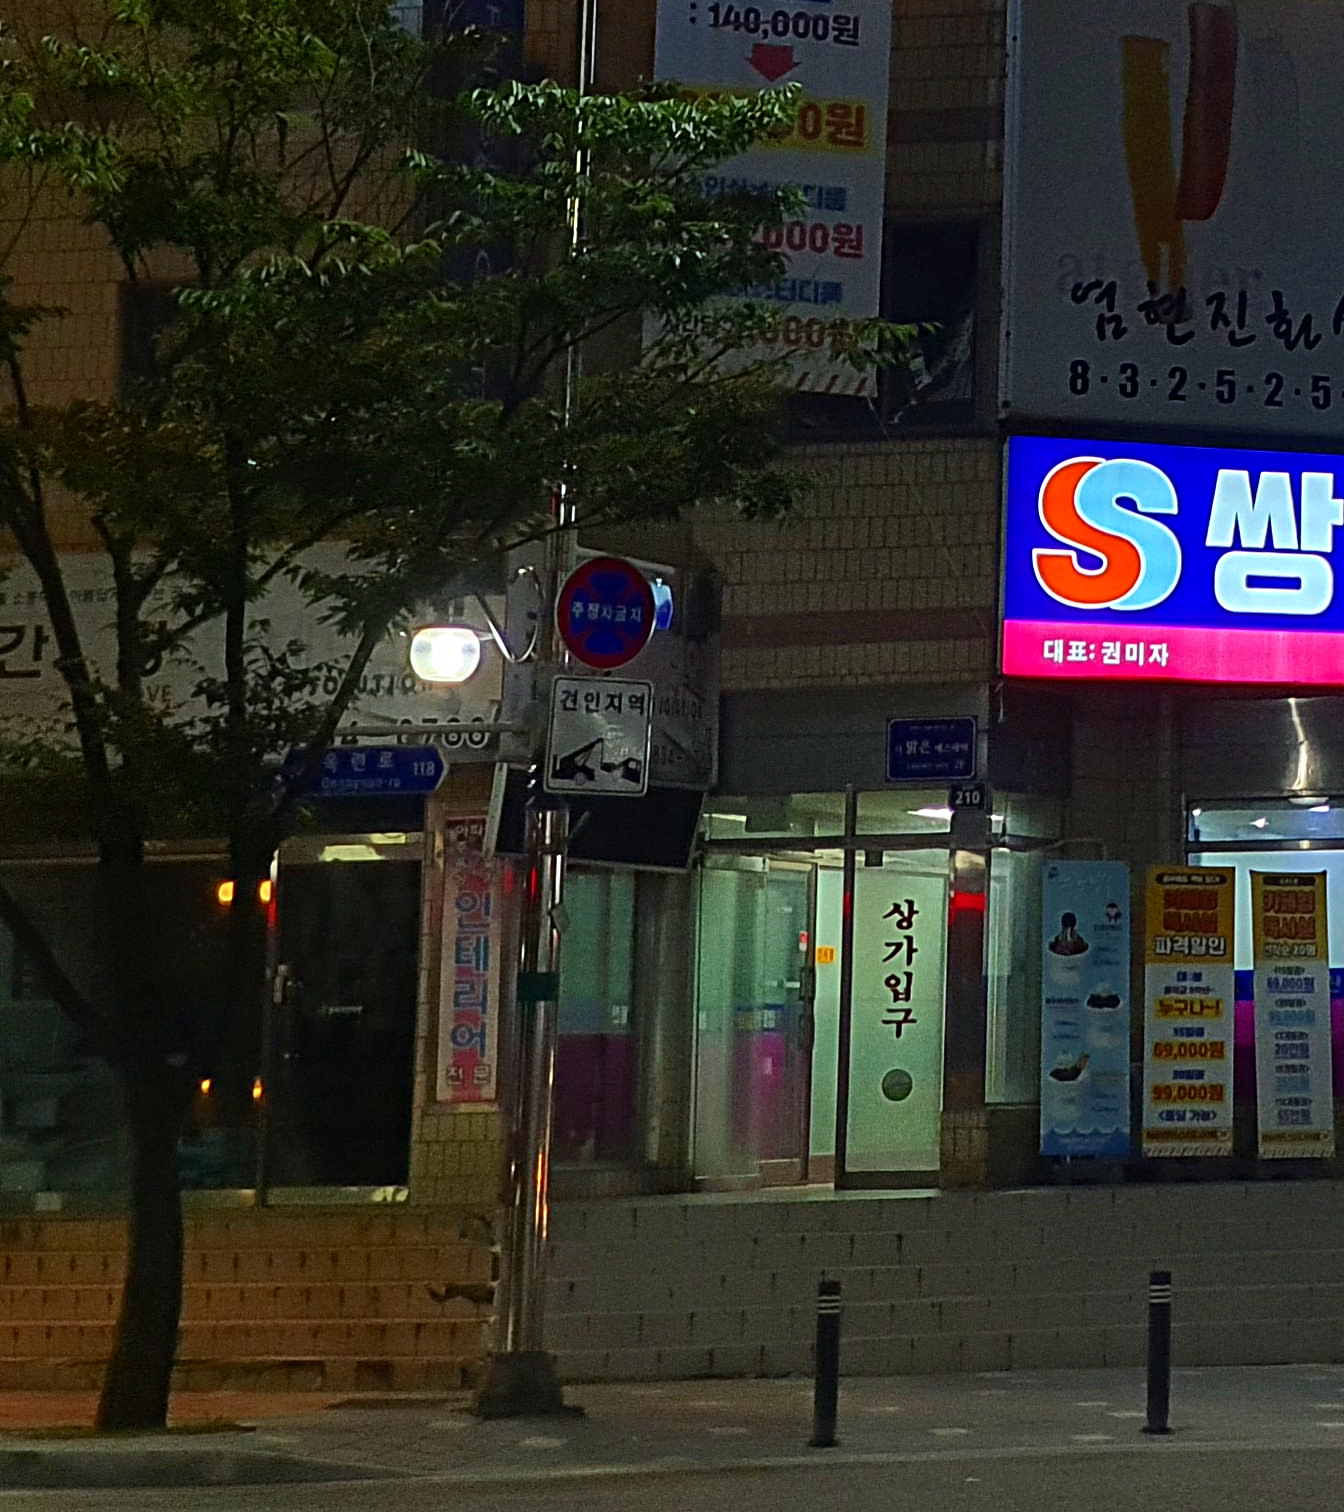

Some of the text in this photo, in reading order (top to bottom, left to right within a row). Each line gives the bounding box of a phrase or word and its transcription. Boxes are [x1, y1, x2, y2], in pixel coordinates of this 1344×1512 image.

[561, 690, 646, 716] 견인지역
[413, 761, 436, 777] 118
[955, 791, 980, 804] 210
[1155, 935, 1226, 956] 파격할인
[451, 891, 491, 1058] 인테리어
[882, 899, 919, 1038] 상가입구
[1154, 1041, 1224, 1059] 69,000원
[1153, 1084, 1223, 1102] 99,000원
